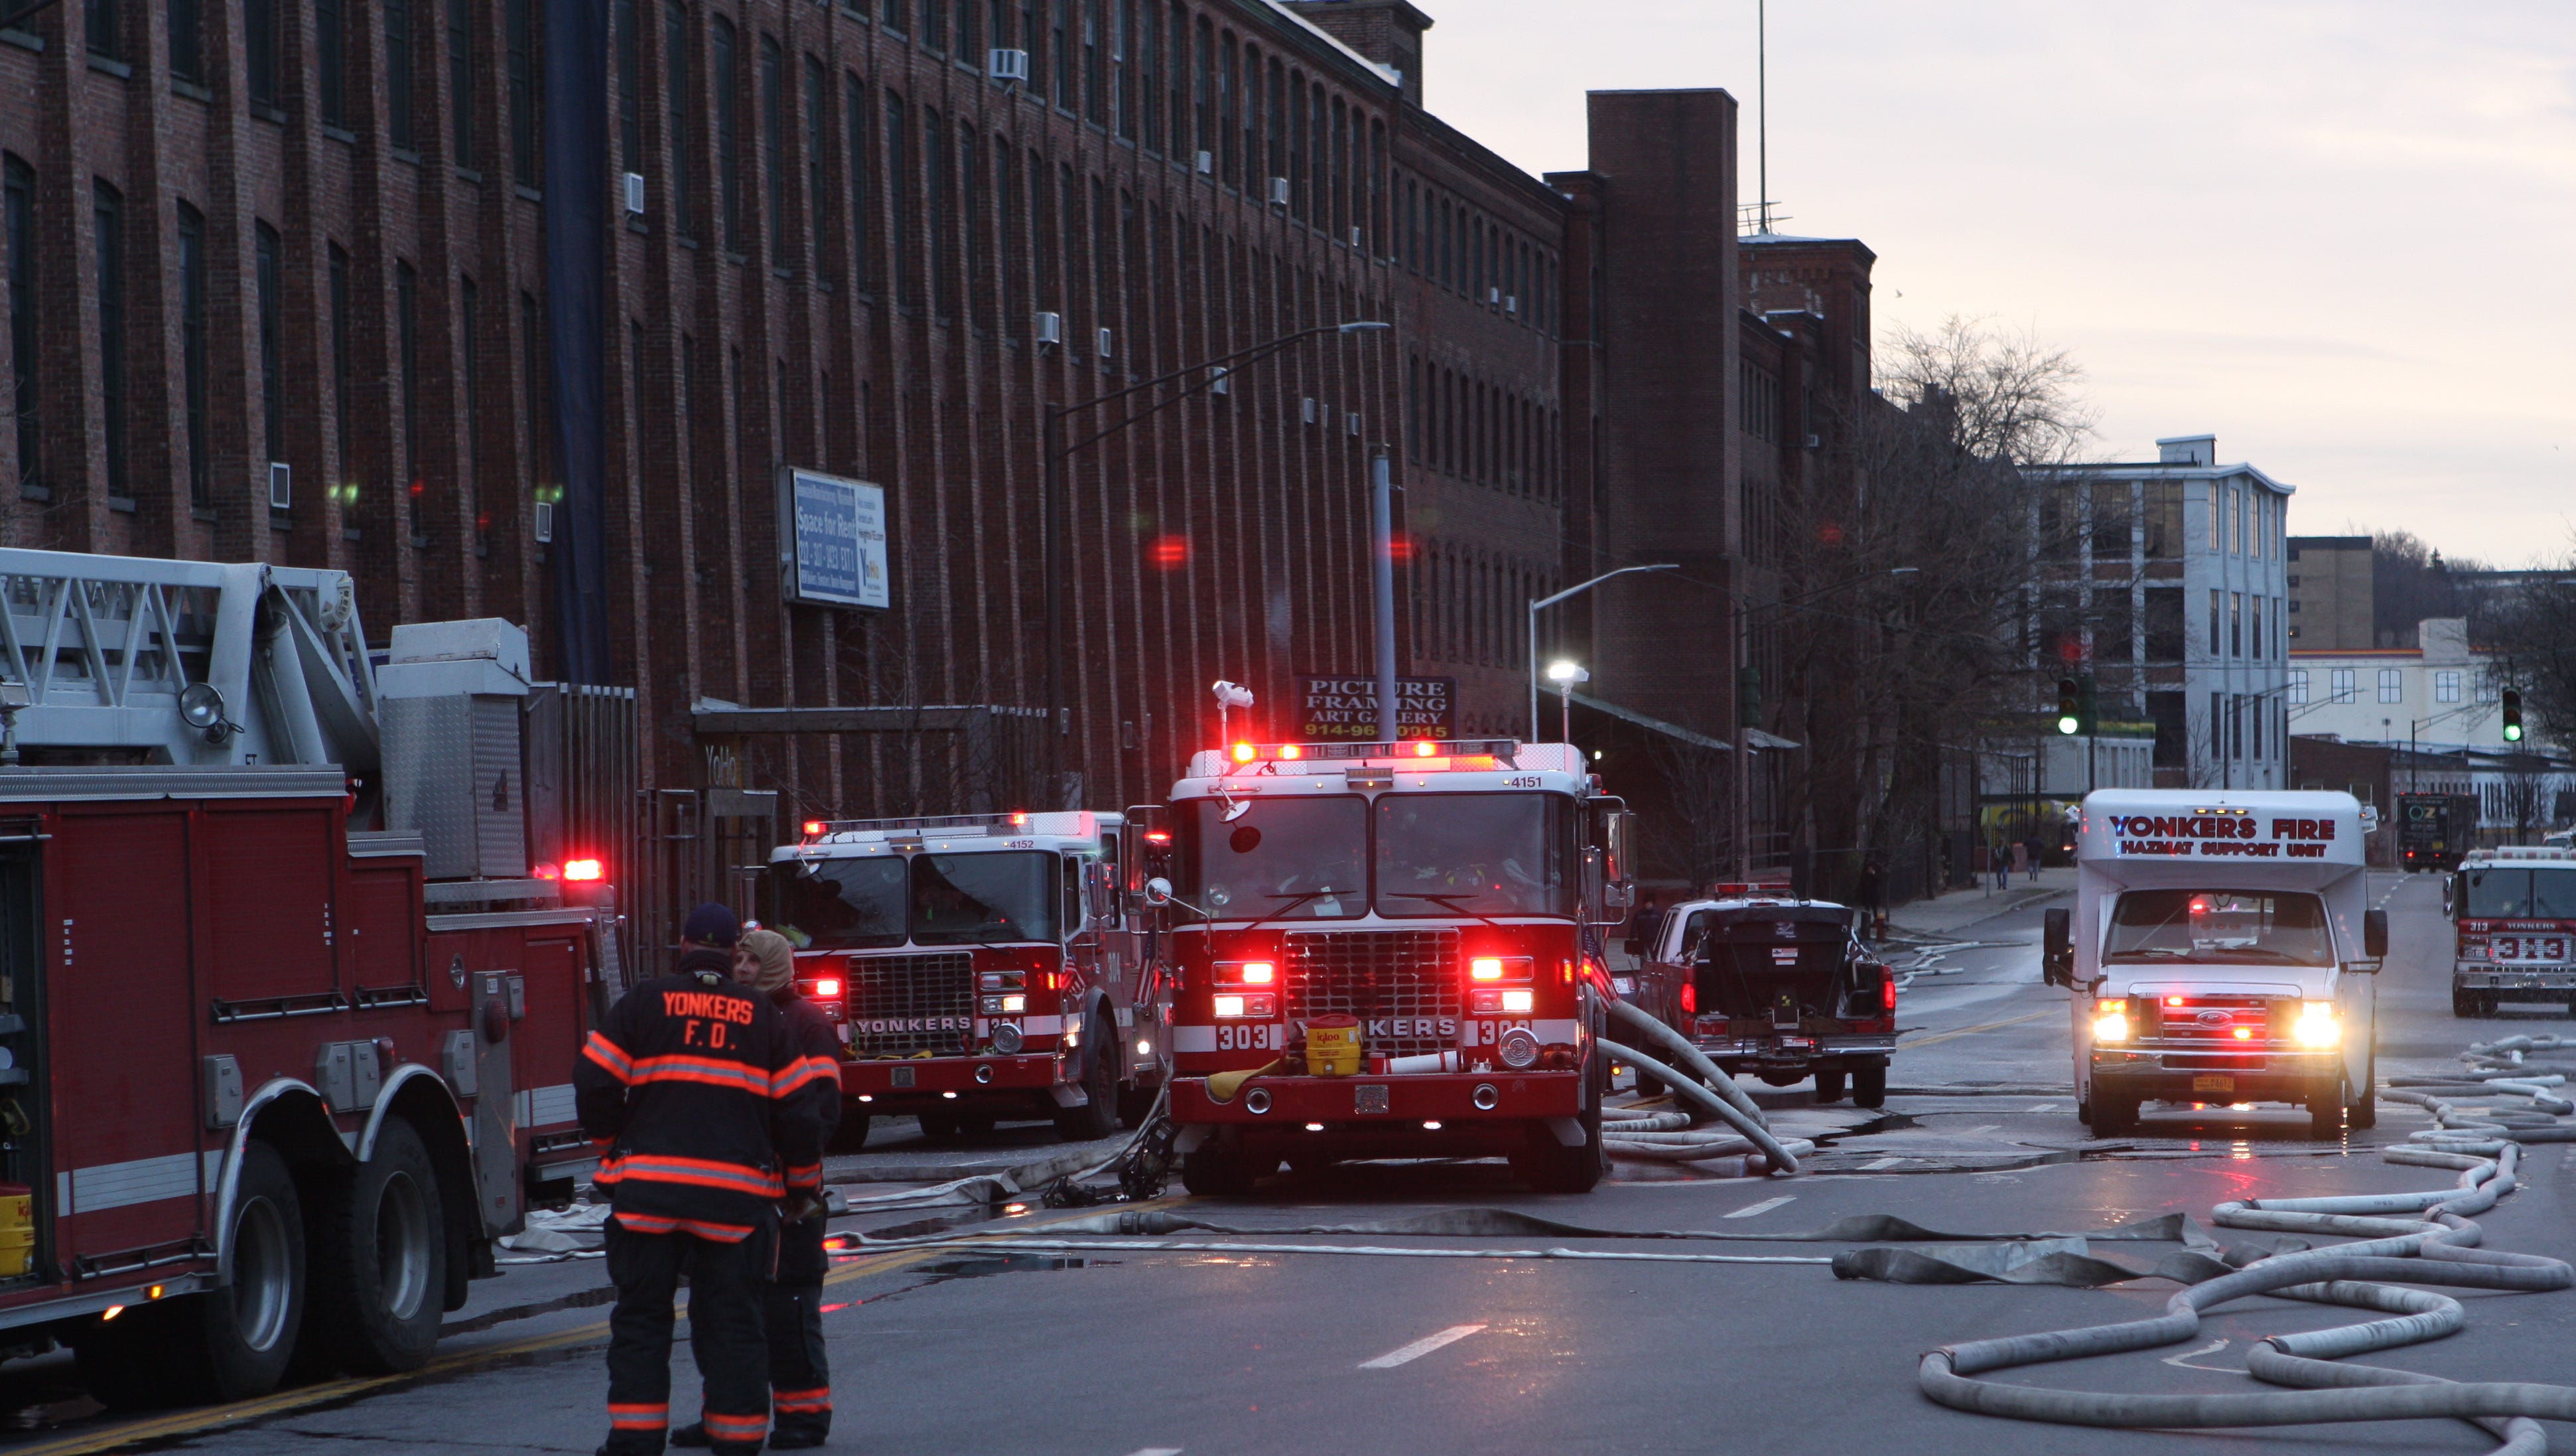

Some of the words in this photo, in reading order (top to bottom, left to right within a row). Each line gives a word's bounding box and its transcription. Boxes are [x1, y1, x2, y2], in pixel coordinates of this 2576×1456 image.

[798, 506, 823, 538] Space
[824, 510, 837, 536] for
[837, 513, 856, 540] Rent
[1310, 711, 1353, 722] ART
[1358, 711, 1442, 724] GERY
[1512, 777, 1541, 788] 4151
[2109, 816, 2256, 839] YONKERS
[2272, 818, 2335, 840] FIRE
[1010, 840, 1034, 849] 4152
[2121, 841, 2193, 856] HAZMAT
[2201, 841, 2279, 857] SUPPORT
[2287, 843, 2327, 857] UNIT
[2471, 922, 2488, 931] 313
[2499, 938, 2563, 960] 313
[663, 992, 754, 1025] YONKERS
[856, 1017, 971, 1033] YONKERS
[1481, 1020, 1530, 1045] 30
[1219, 1025, 1268, 1050] 303
[1317, 1032, 1339, 1044] igloo
